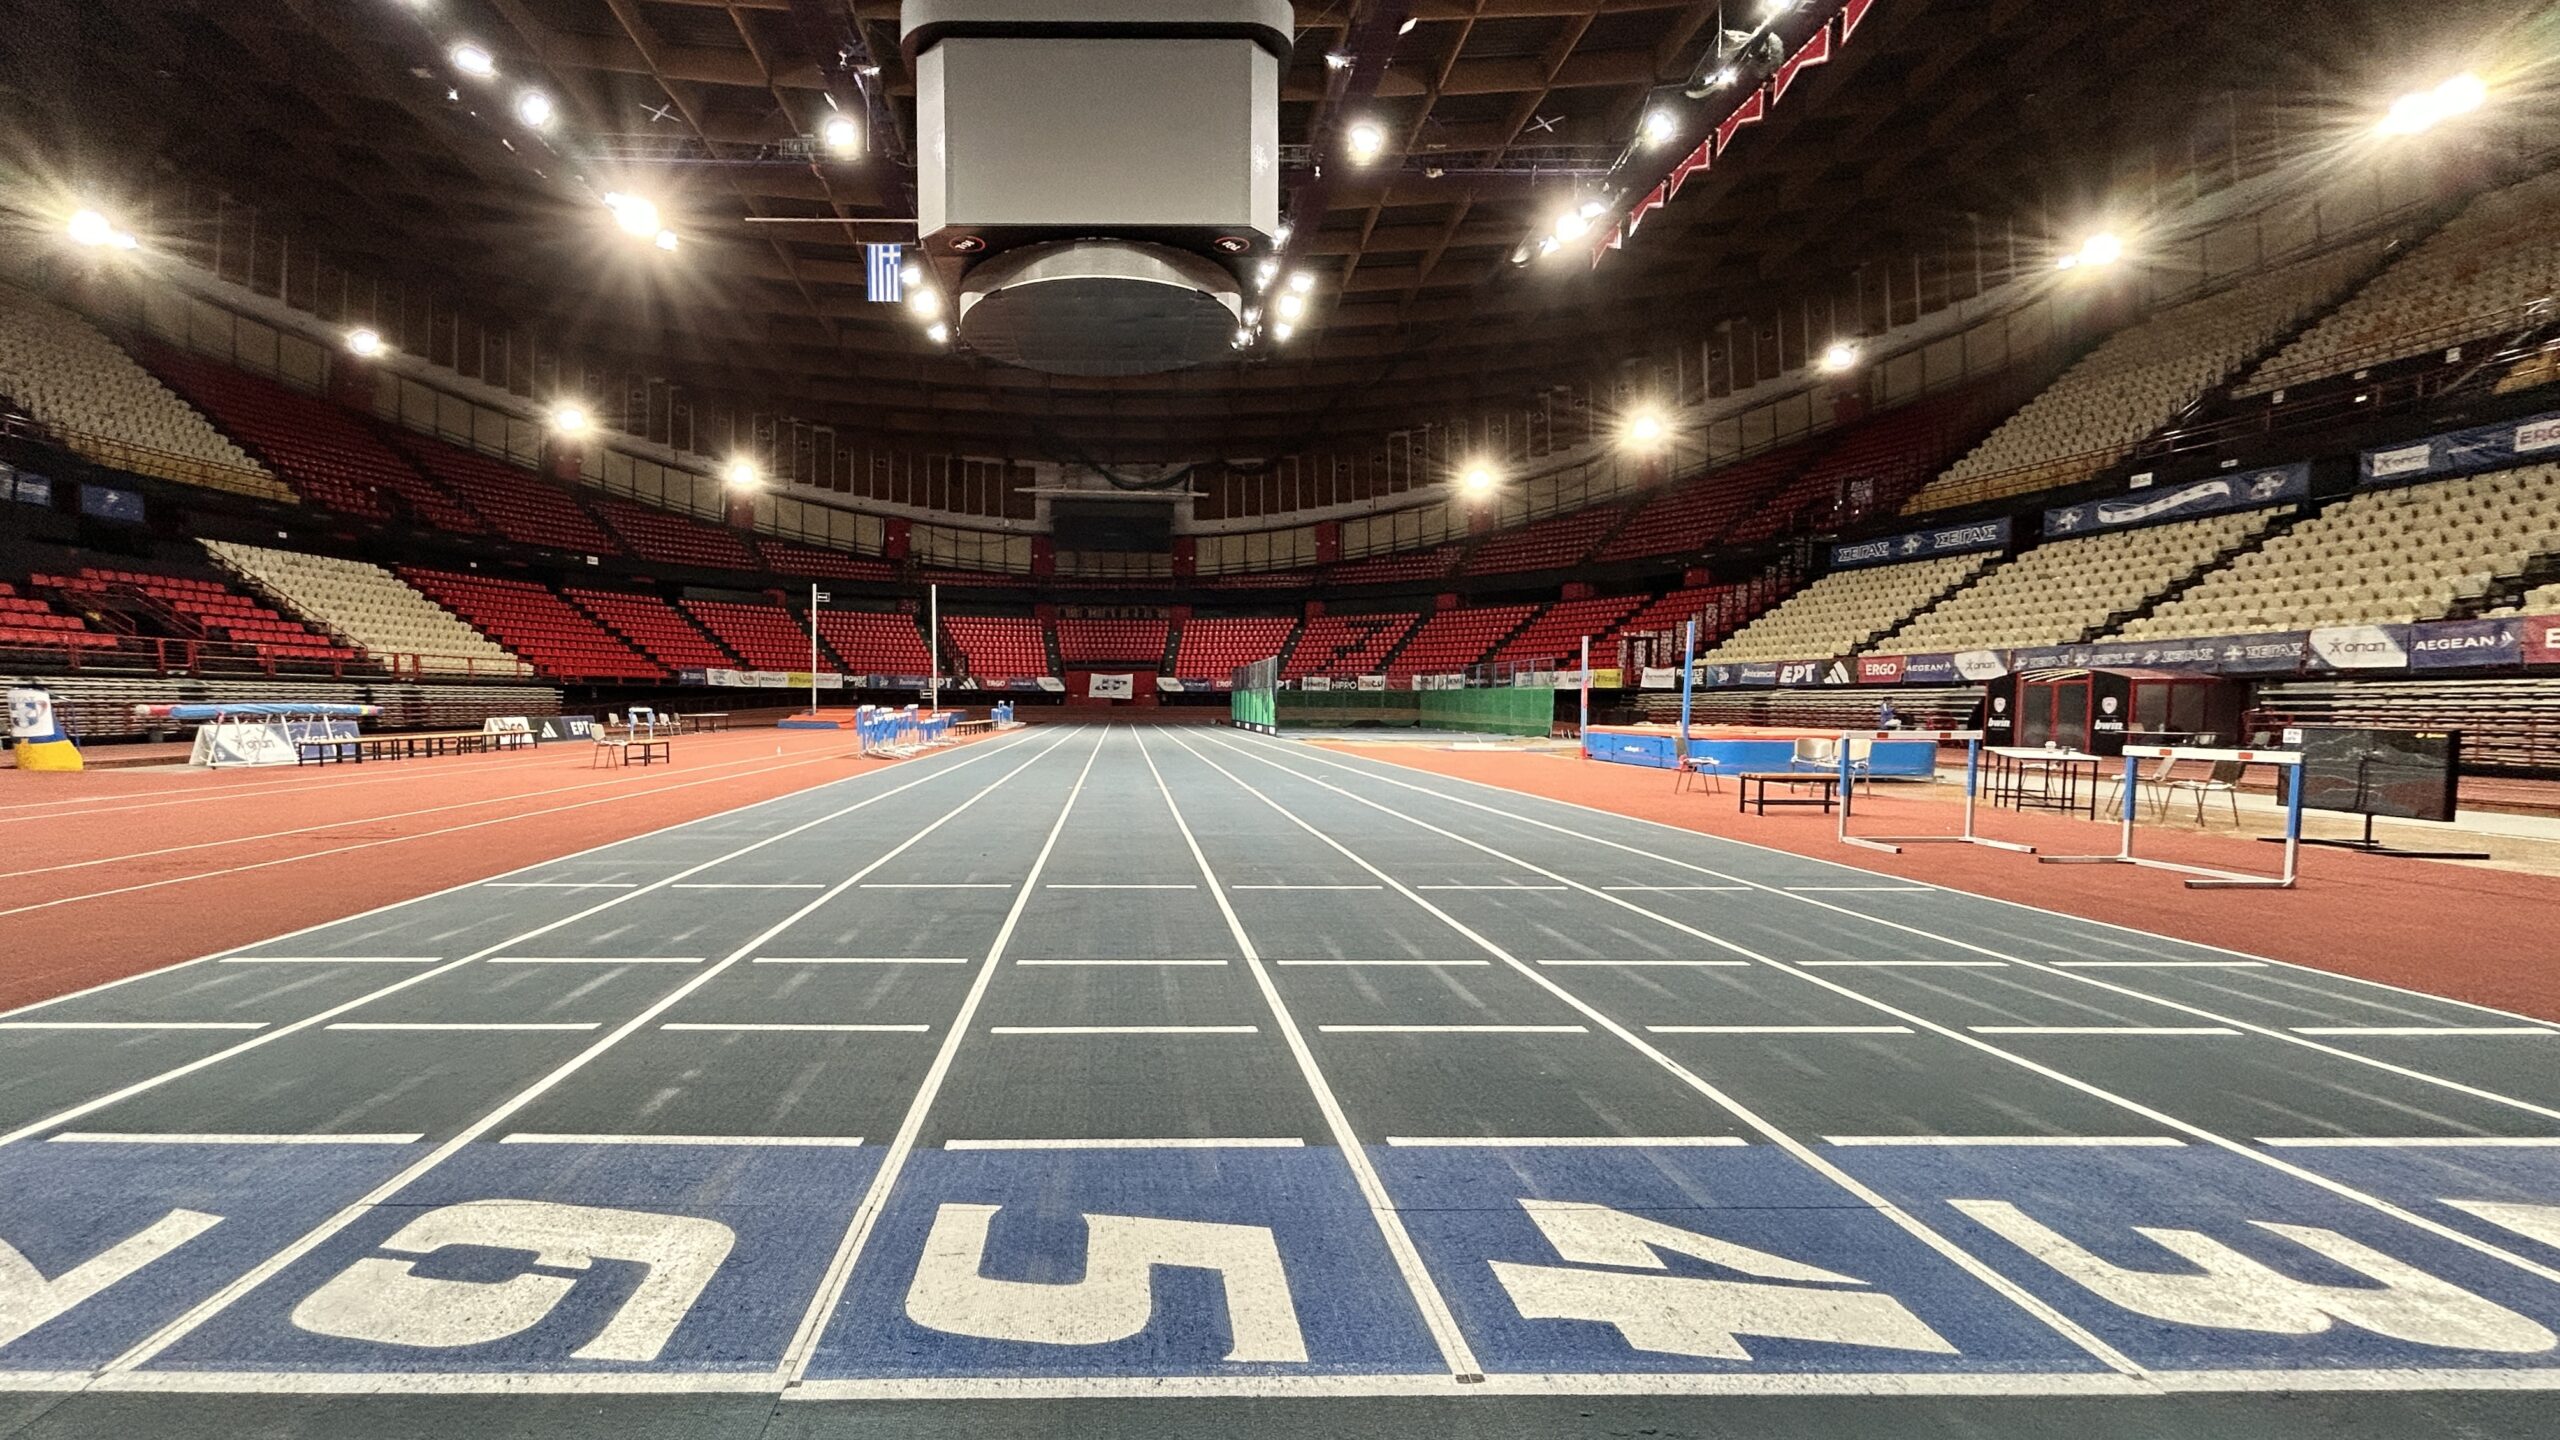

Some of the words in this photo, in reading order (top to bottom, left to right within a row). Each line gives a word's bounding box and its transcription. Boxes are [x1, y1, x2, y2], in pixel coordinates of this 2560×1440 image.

[1933, 524, 1997, 548] ΣΕΓΑΣ
[1838, 541, 1890, 562] ΣΕΓΑΣ
[2414, 635, 2496, 651] AEGEAN
[1865, 663, 1897, 676] ERGO
[1905, 663, 1945, 673] AEGEAN
[1987, 717, 2012, 728] bwin
[2094, 719, 2124, 731] bwin
[904, 1203, 1310, 1363] 5
[1487, 1198, 1962, 1362] 4
[1947, 1198, 2558, 1355] 3
